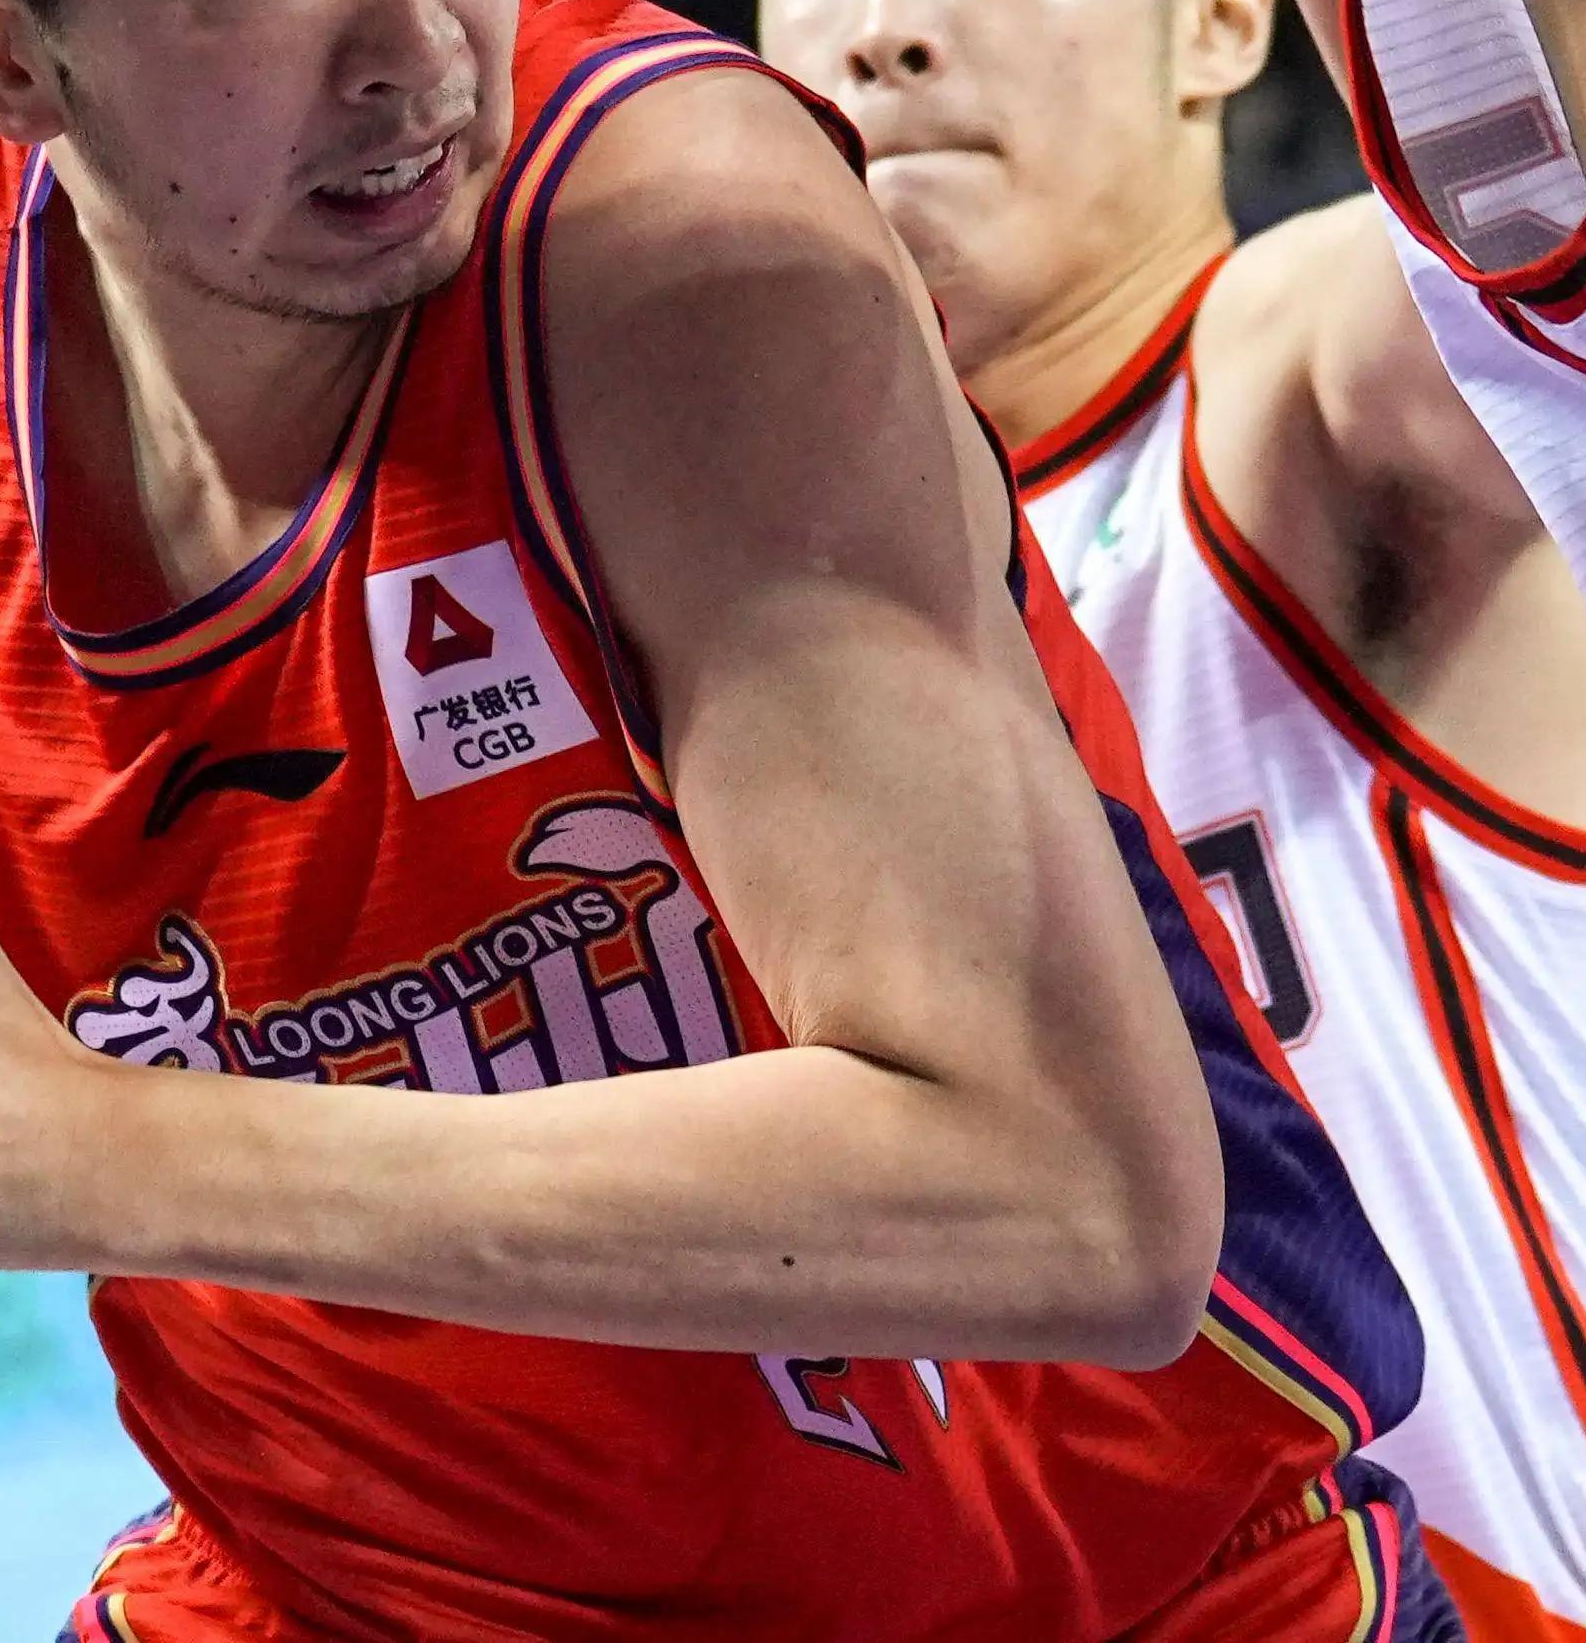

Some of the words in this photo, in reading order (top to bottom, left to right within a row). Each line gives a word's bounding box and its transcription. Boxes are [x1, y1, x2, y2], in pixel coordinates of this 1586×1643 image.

[414, 675, 540, 742] 广发银行
[453, 722, 536, 769] CGB
[232, 978, 438, 1068] LOONG
[441, 890, 618, 998] LIONS
